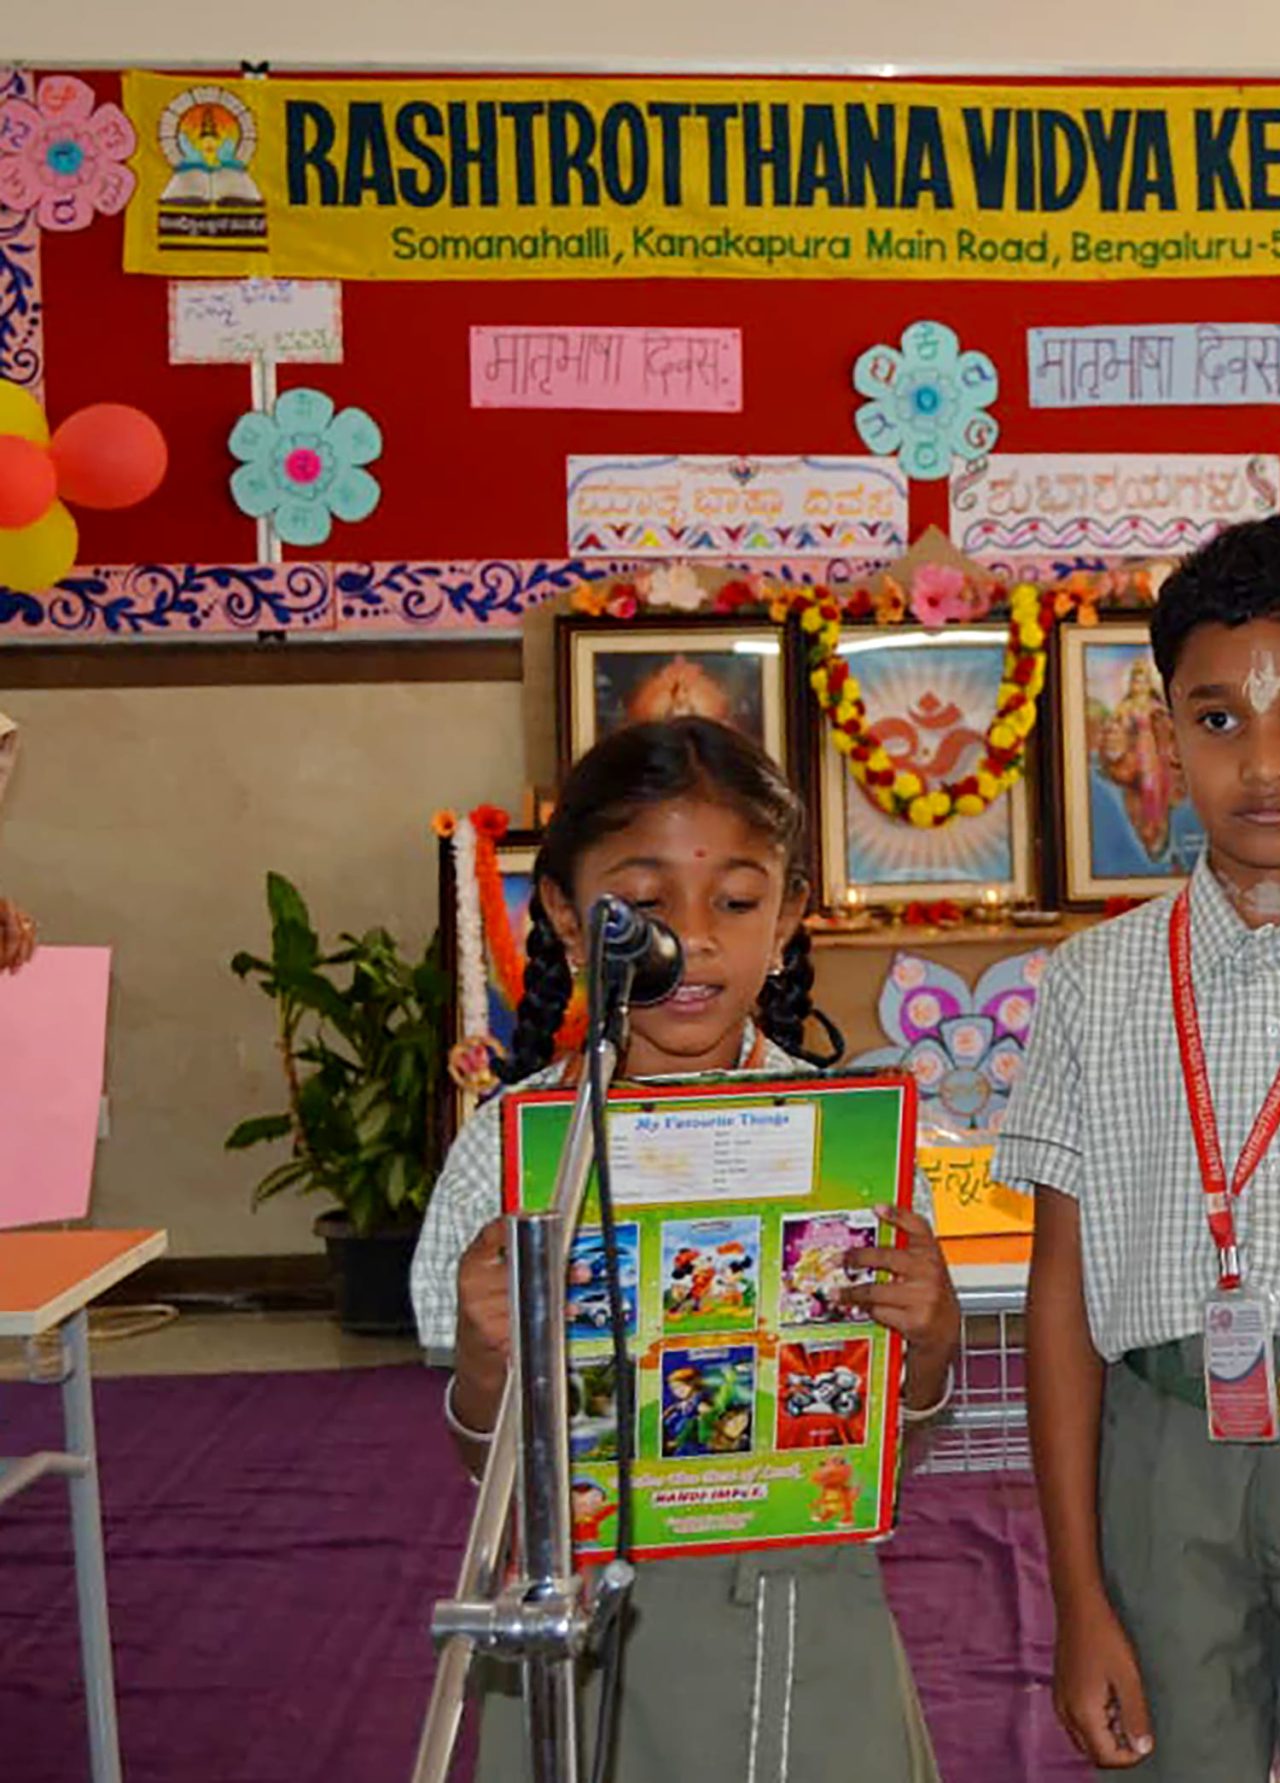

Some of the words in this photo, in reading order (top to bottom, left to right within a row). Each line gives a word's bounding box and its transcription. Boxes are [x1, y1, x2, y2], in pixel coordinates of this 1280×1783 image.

[285, 99, 954, 209] RASHTROTTHANA
[962, 105, 1177, 213] VIDYA
[632, 226, 852, 264] Kanakapura
[866, 228, 947, 261] Main
[956, 227, 1060, 268] Road,
[635, 1115, 660, 1133] My
[664, 1114, 735, 1130] Favourite
[740, 1111, 790, 1128] Things
